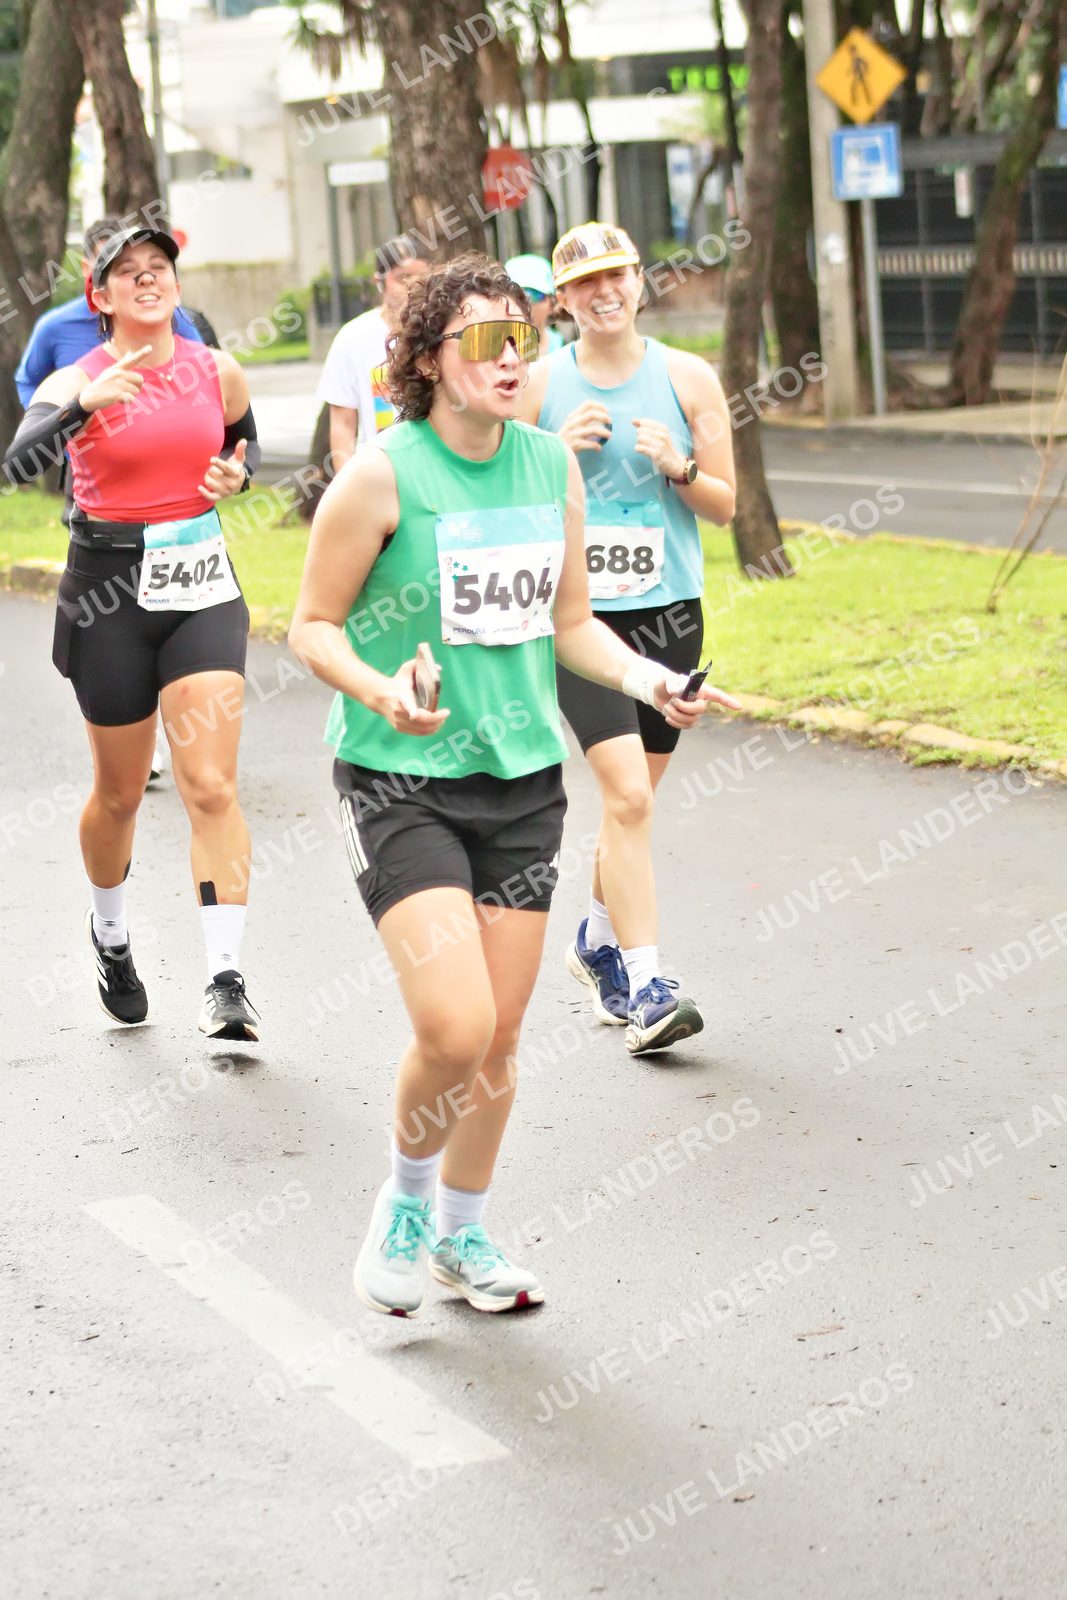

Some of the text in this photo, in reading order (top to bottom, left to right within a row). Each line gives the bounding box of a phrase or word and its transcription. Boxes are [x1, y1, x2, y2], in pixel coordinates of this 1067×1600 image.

[147, 553, 225, 590] 5402
[585, 544, 655, 575] 688
[452, 567, 553, 616] 5404
